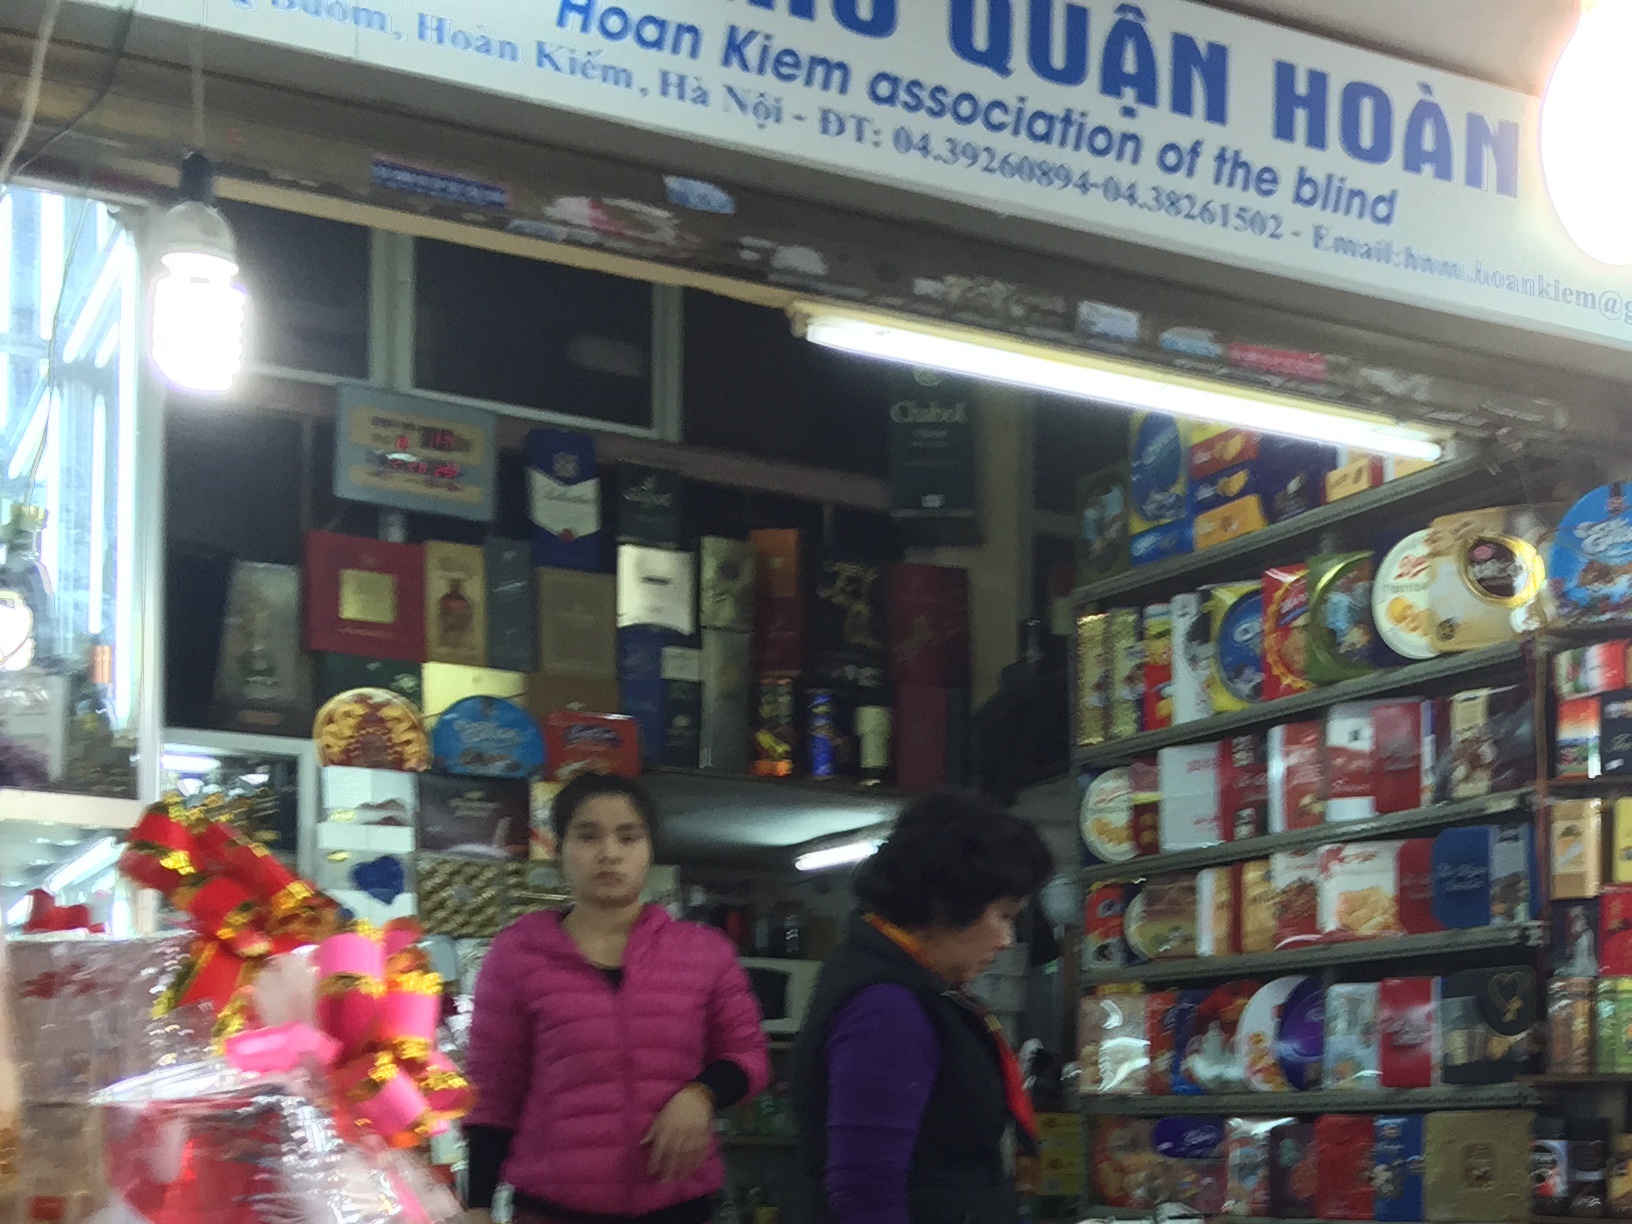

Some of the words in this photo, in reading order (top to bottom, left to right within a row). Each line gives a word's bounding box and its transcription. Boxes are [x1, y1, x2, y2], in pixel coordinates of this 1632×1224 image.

[417, 11, 524, 64] Hoàn
[658, 68, 711, 108] Hà
[722, 83, 785, 130] Nội
[556, 0, 702, 60] Hoan
[721, 24, 852, 96] Kiem
[868, 70, 1142, 166] association
[1157, 137, 1205, 179] of
[1213, 145, 1281, 197] the
[1292, 166, 1397, 226] blind
[948, 0, 1230, 126] QUẬN
[1272, 58, 1519, 198] HOÀN
